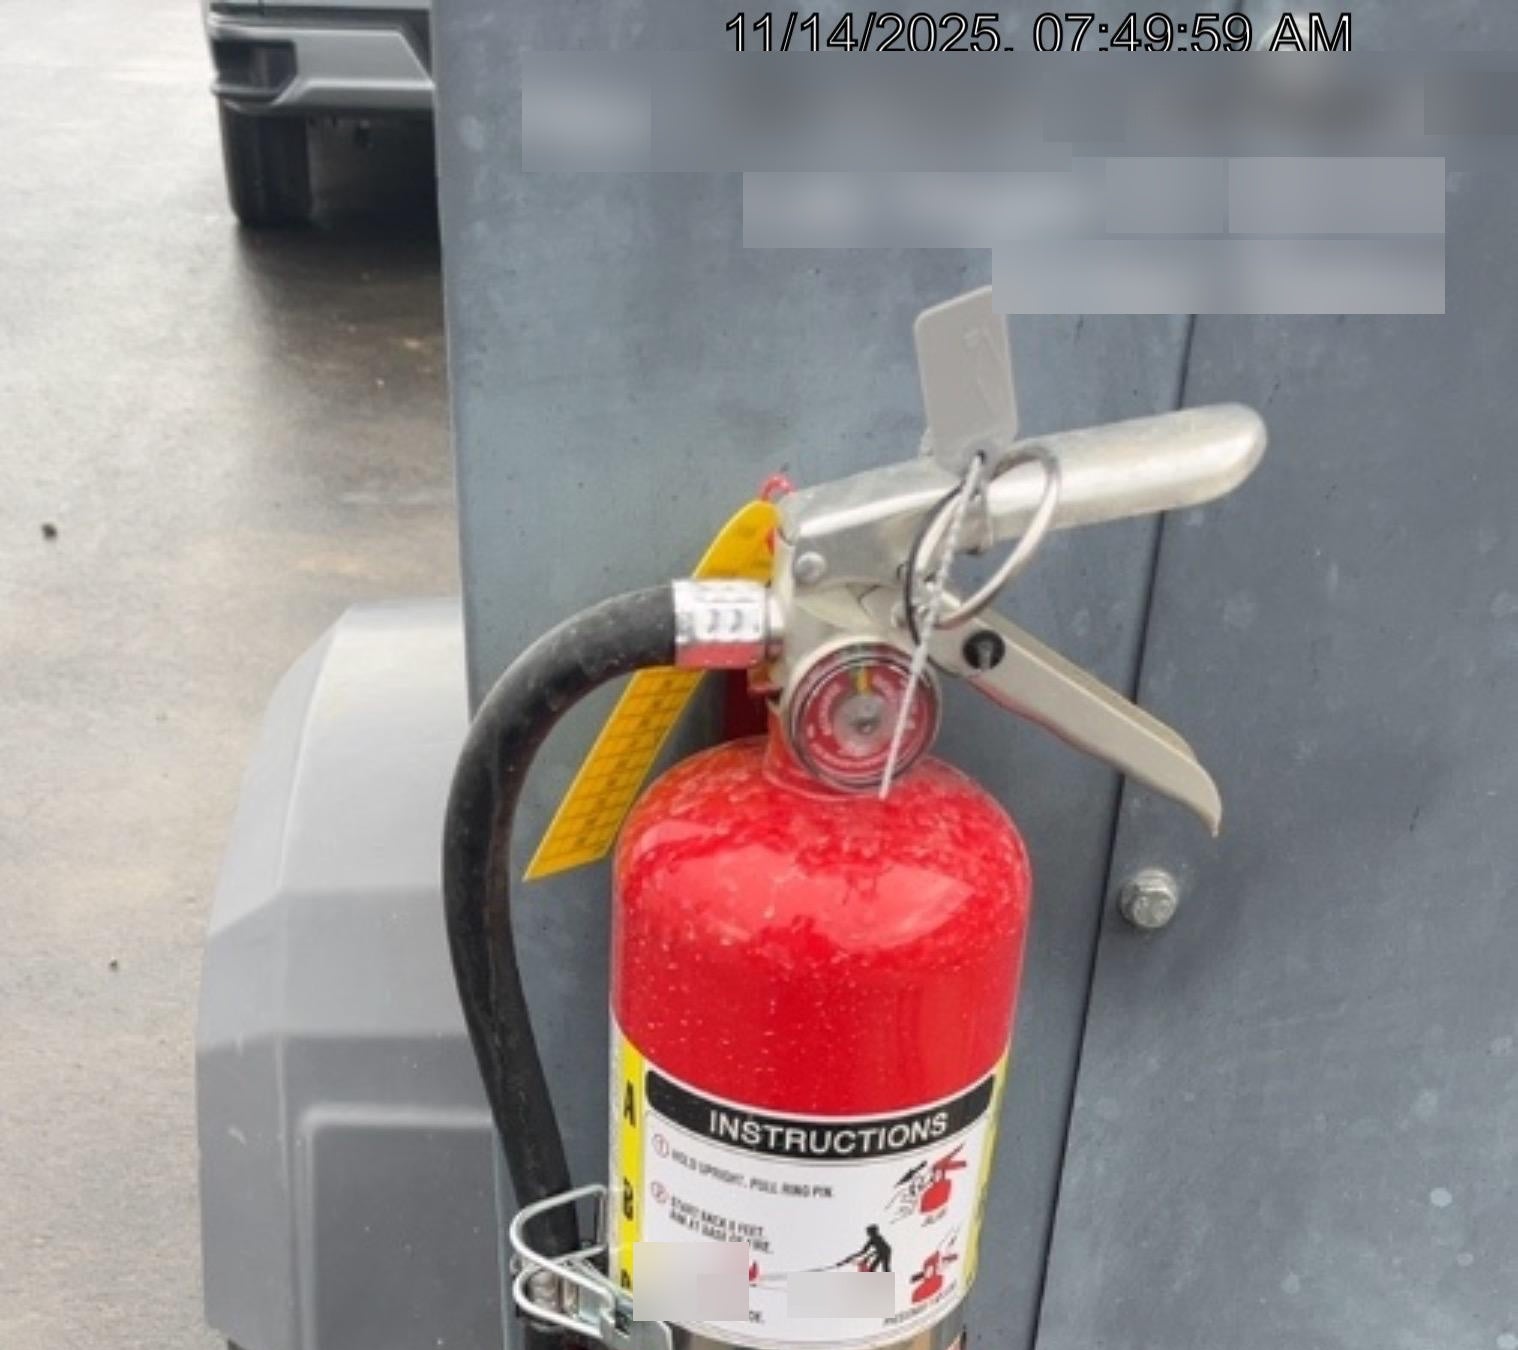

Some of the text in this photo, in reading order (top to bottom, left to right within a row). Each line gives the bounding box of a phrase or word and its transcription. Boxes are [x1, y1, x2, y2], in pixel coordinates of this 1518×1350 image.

[709, 1111, 948, 1155] INSTRUCTIONS
[672, 1149, 696, 1171] HOLD
[749, 1178, 777, 1194] PULL
[781, 1182, 811, 1197] RING
[688, 1217, 700, 1232] AT
[701, 1224, 727, 1242] BASE
[701, 1210, 727, 1227] BACK
[738, 1222, 763, 1237] FEET
